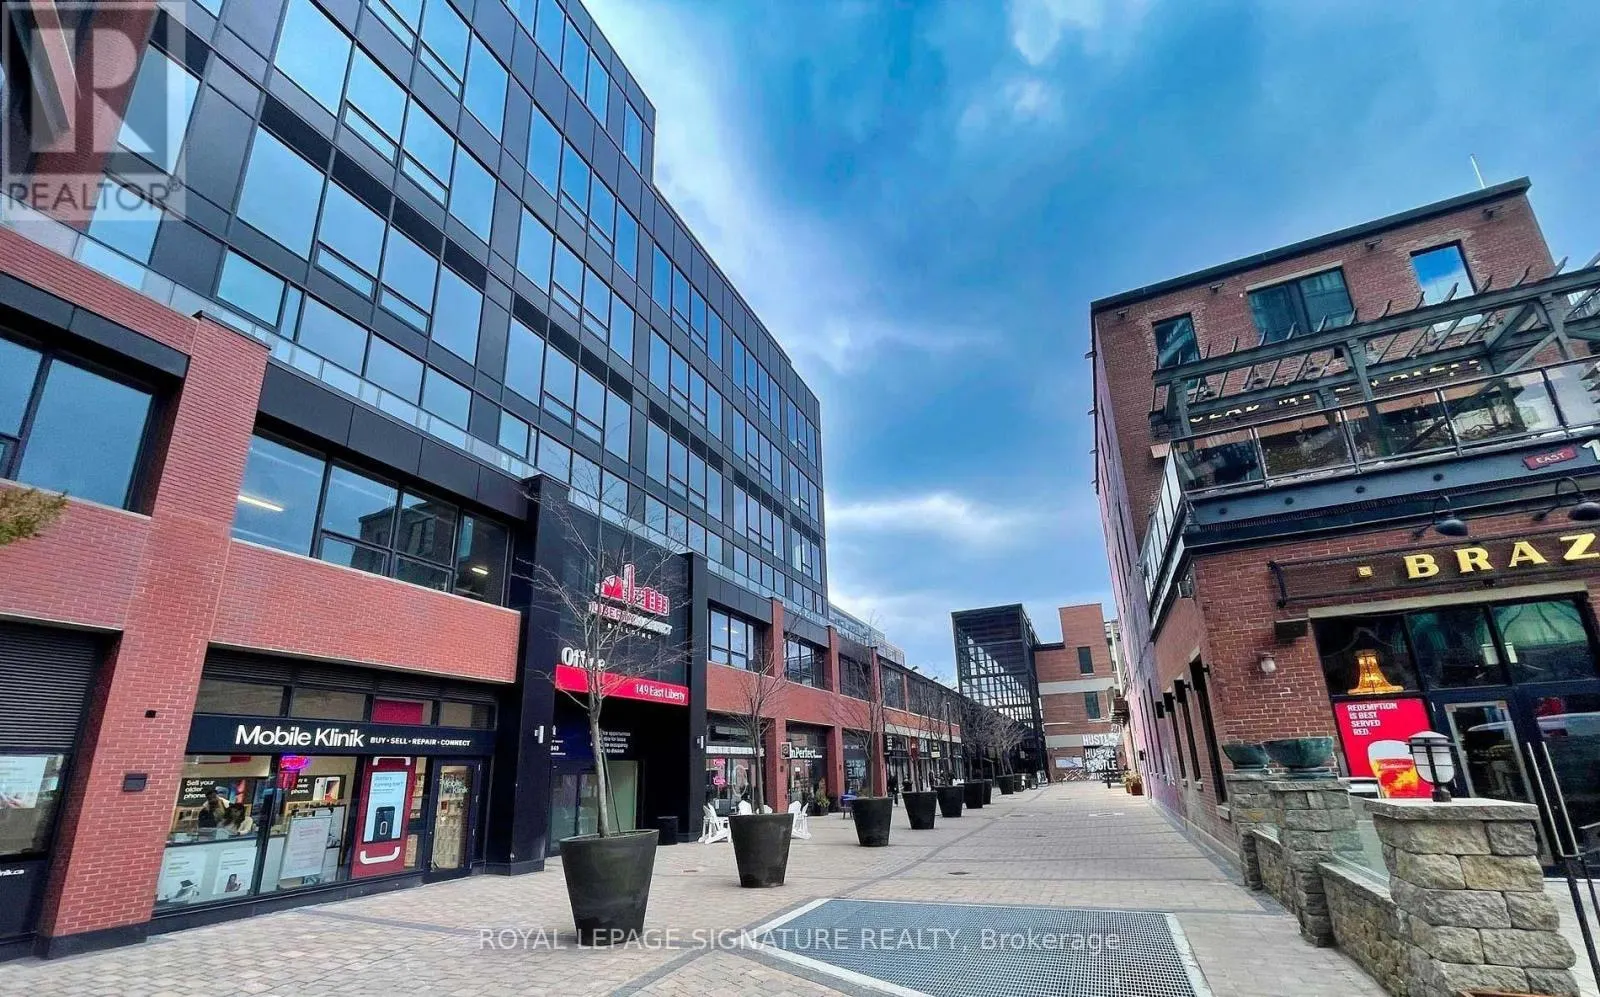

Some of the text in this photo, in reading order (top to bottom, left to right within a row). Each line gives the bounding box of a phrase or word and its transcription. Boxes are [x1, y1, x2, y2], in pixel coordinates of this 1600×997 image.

[1536, 452, 1566, 464] EAST
[635, 684, 686, 703] 149 East Liberty
[1347, 703, 1398, 711] REDEMPTION
[1350, 711, 1377, 720] IS BEST
[1351, 719, 1381, 728] SERVED
[235, 724, 365, 748] Mobile Klinik
[390, 737, 408, 745] SELL
[412, 738, 437, 746] REPAIR
[440, 739, 471, 747] CONNECT
